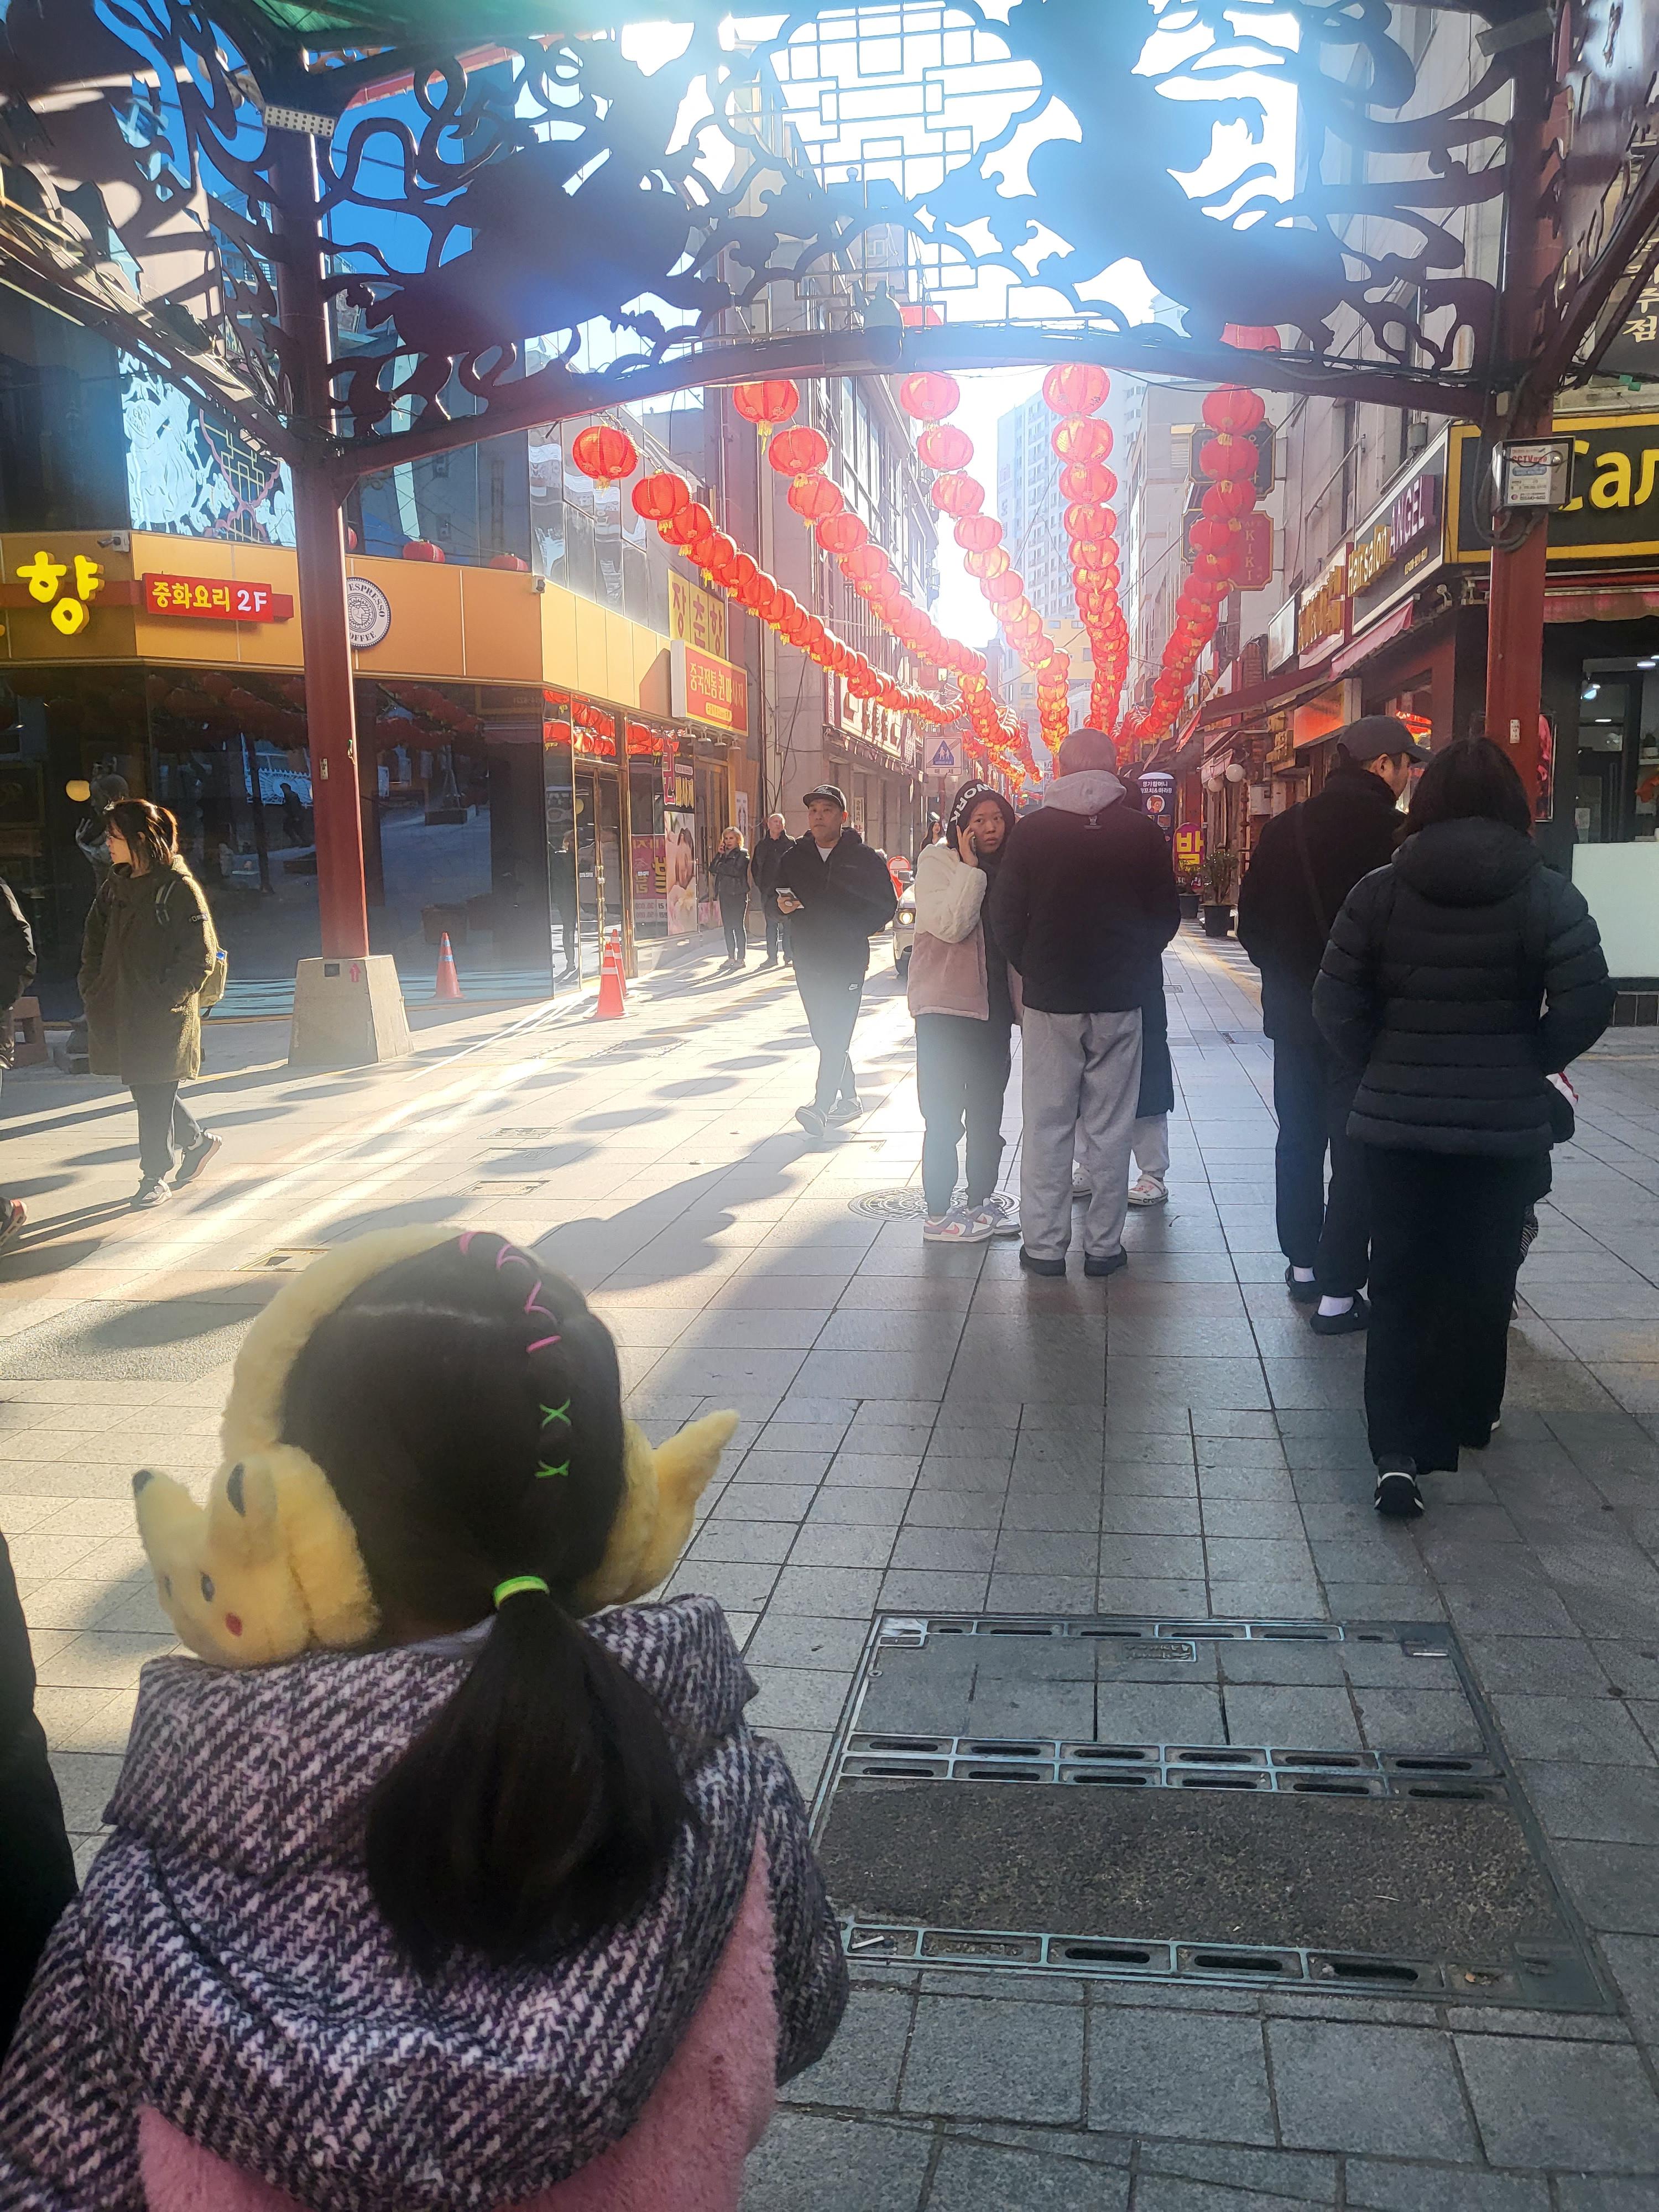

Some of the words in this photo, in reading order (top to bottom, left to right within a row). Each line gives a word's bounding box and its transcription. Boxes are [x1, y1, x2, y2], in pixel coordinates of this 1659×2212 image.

[1389, 475, 1425, 558] ANGEL
[1245, 529, 1255, 581] KIKI
[16, 551, 101, 635] 향
[152, 581, 230, 612] 중화요리
[237, 589, 267, 612] 2F
[348, 583, 385, 617] ESPRESSO
[672, 581, 723, 657] 장춘향
